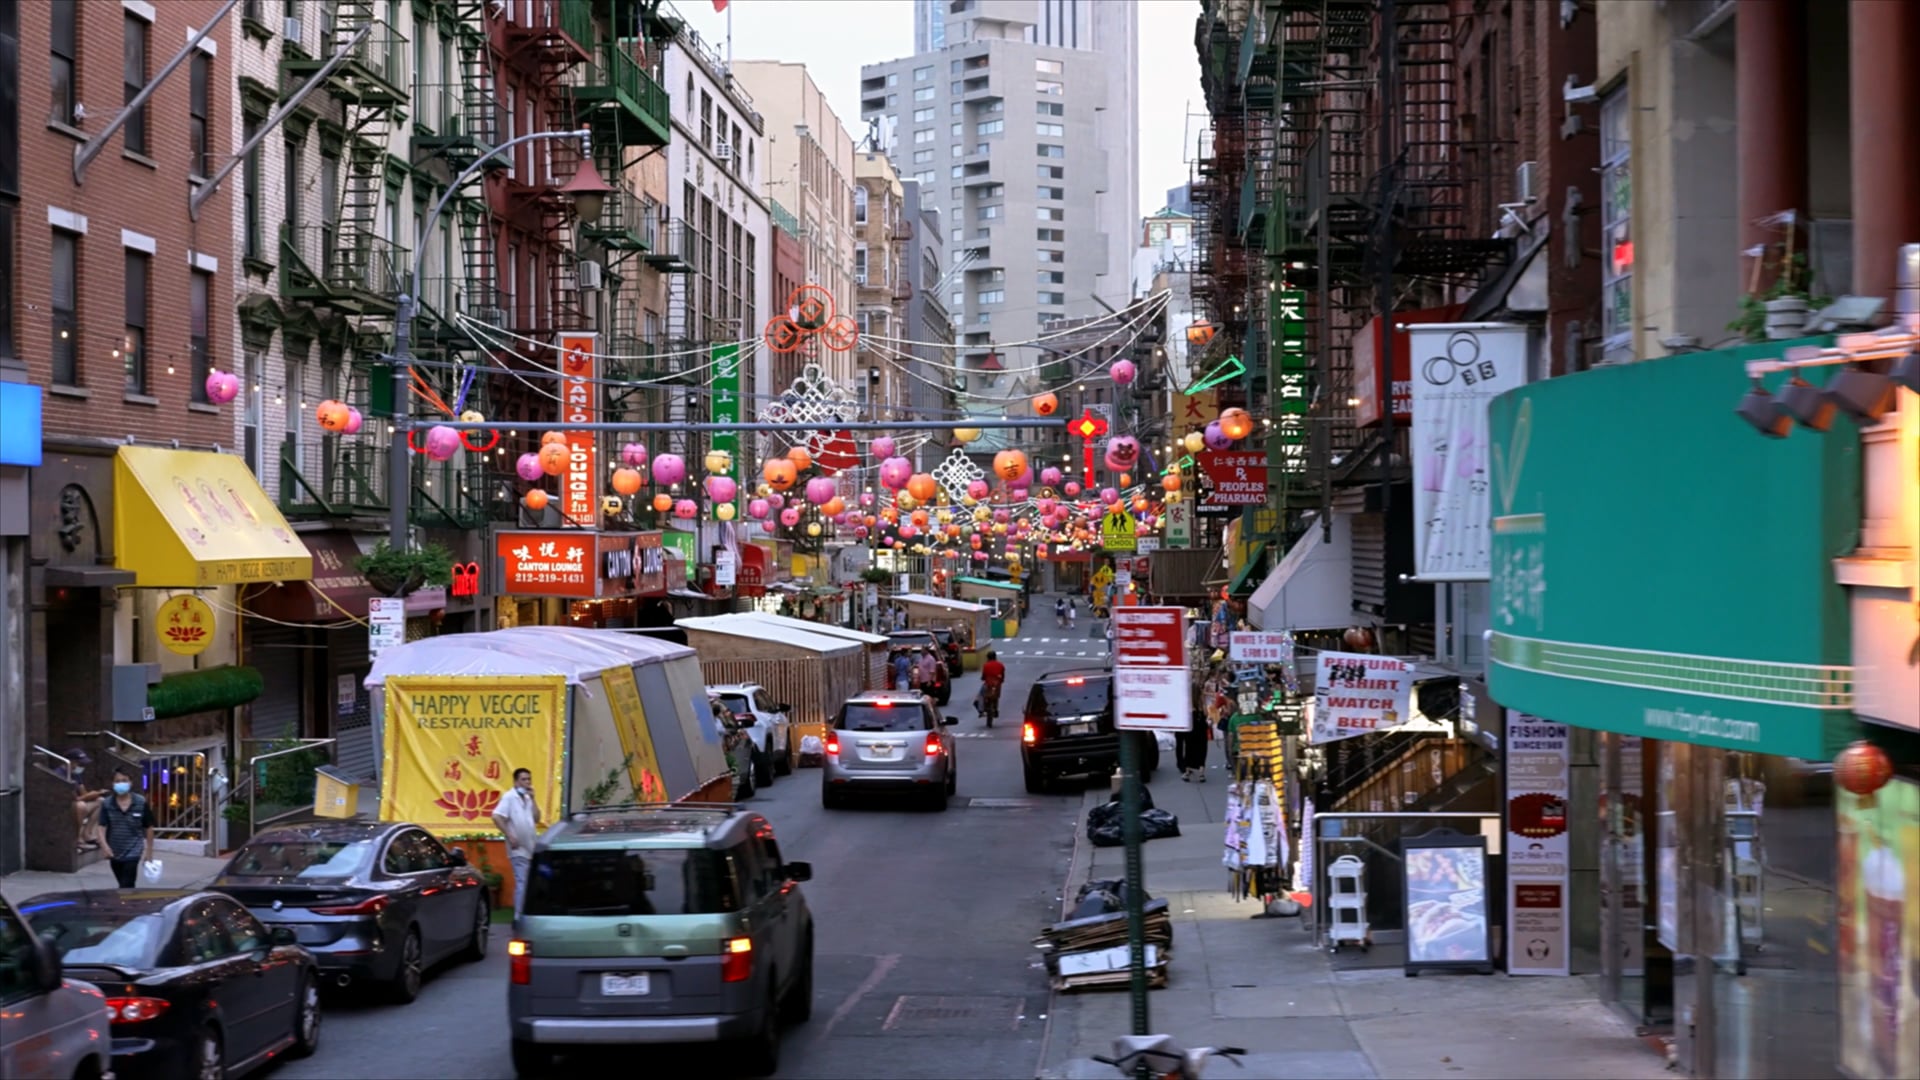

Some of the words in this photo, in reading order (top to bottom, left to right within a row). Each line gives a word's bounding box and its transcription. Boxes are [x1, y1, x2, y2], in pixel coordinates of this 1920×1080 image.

[569, 374, 588, 433] CANTO
[569, 443, 588, 500] LOUNGE
[1219, 482, 1264, 492] PEOPLES
[517, 562, 549, 572] CANTON
[551, 563, 583, 572] LOUNGE
[515, 573, 585, 583] 212-219-1431
[1324, 657, 1407, 671] PERFUME
[411, 695, 470, 715] HAPPY
[480, 694, 541, 714] VEGGIE
[1327, 697, 1394, 709] WATCH
[417, 717, 534, 729] RESTAURANT
[1337, 717, 1378, 729] BELT
[1510, 726, 1567, 738] FISHION
